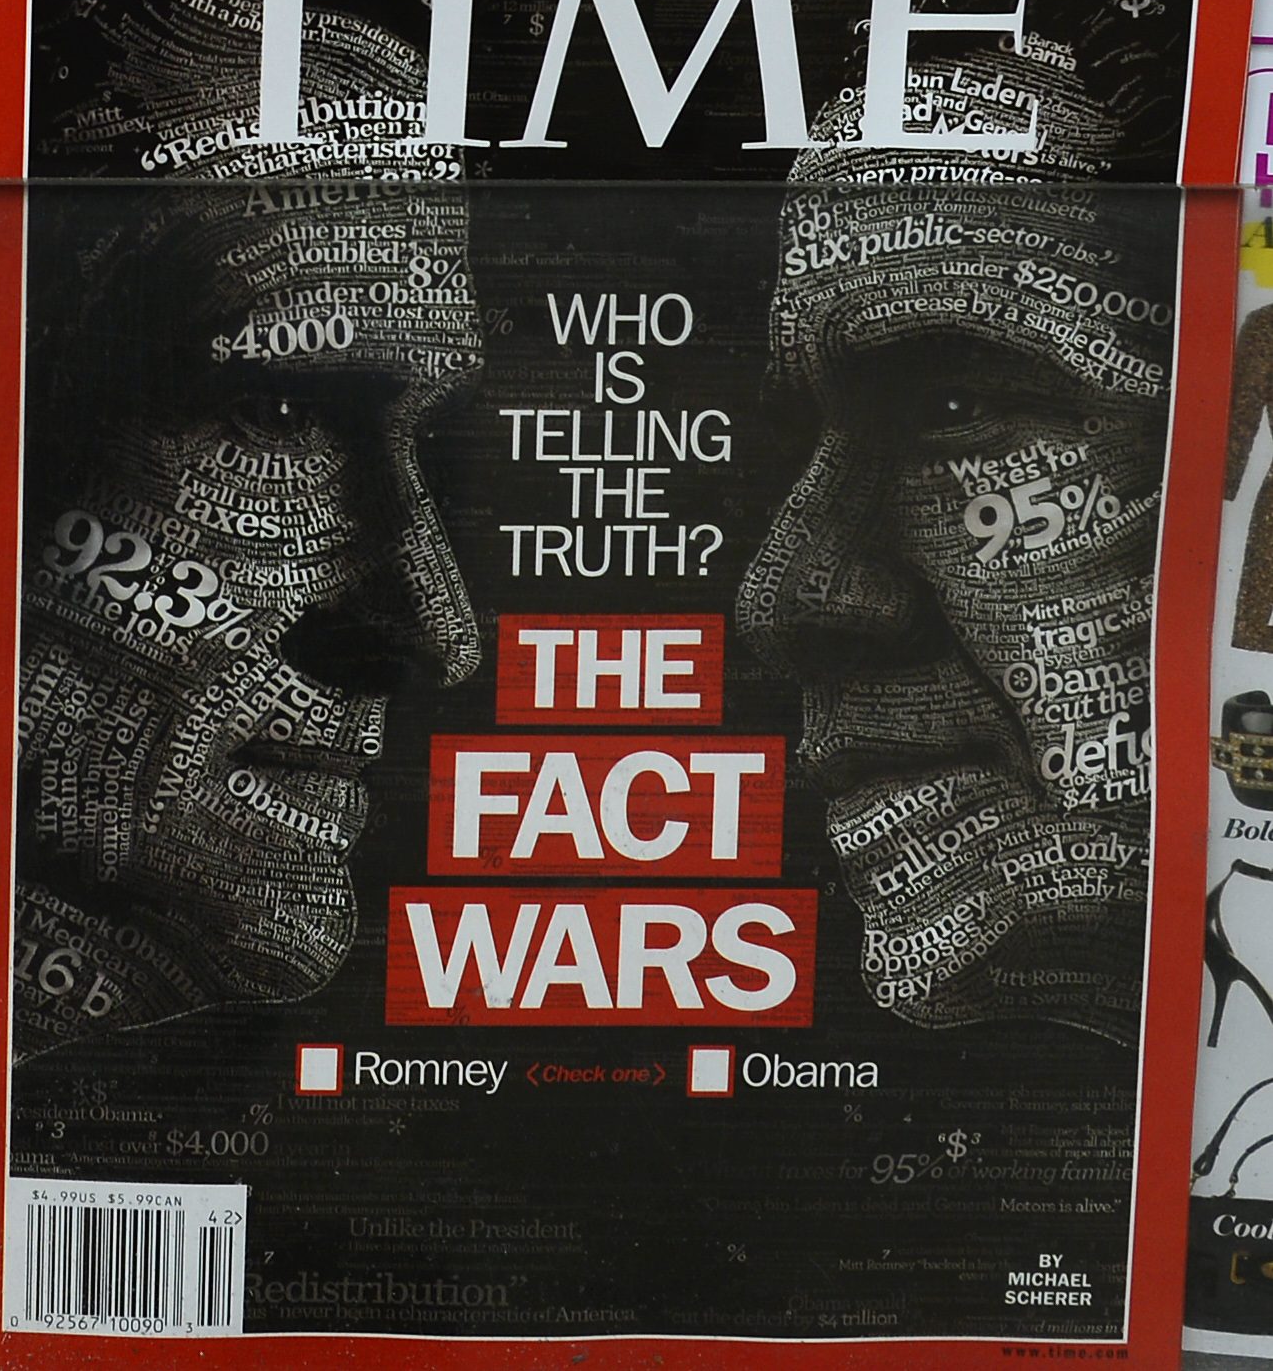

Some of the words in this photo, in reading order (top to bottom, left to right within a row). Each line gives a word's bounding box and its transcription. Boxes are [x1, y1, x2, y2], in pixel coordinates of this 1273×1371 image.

[547, 293, 694, 347] WHO
[1013, 259, 1174, 328] $250,000
[595, 351, 646, 404] IS
[498, 409, 732, 462] TELLING
[173, 486, 282, 539] taxes
[559, 467, 671, 519] THE
[964, 474, 1121, 562] 95%
[498, 525, 724, 577] TRUTH?
[518, 629, 702, 709] THE
[452, 750, 766, 862] FACT
[405, 902, 797, 1012] WARS
[354, 1050, 508, 1094] Romney
[742, 1053, 880, 1088] Obama
[1007, 1272, 1092, 1289] MICHAEL
[1038, 1254, 1064, 1269] BY
[1004, 1290, 1093, 1307] SCHERER
